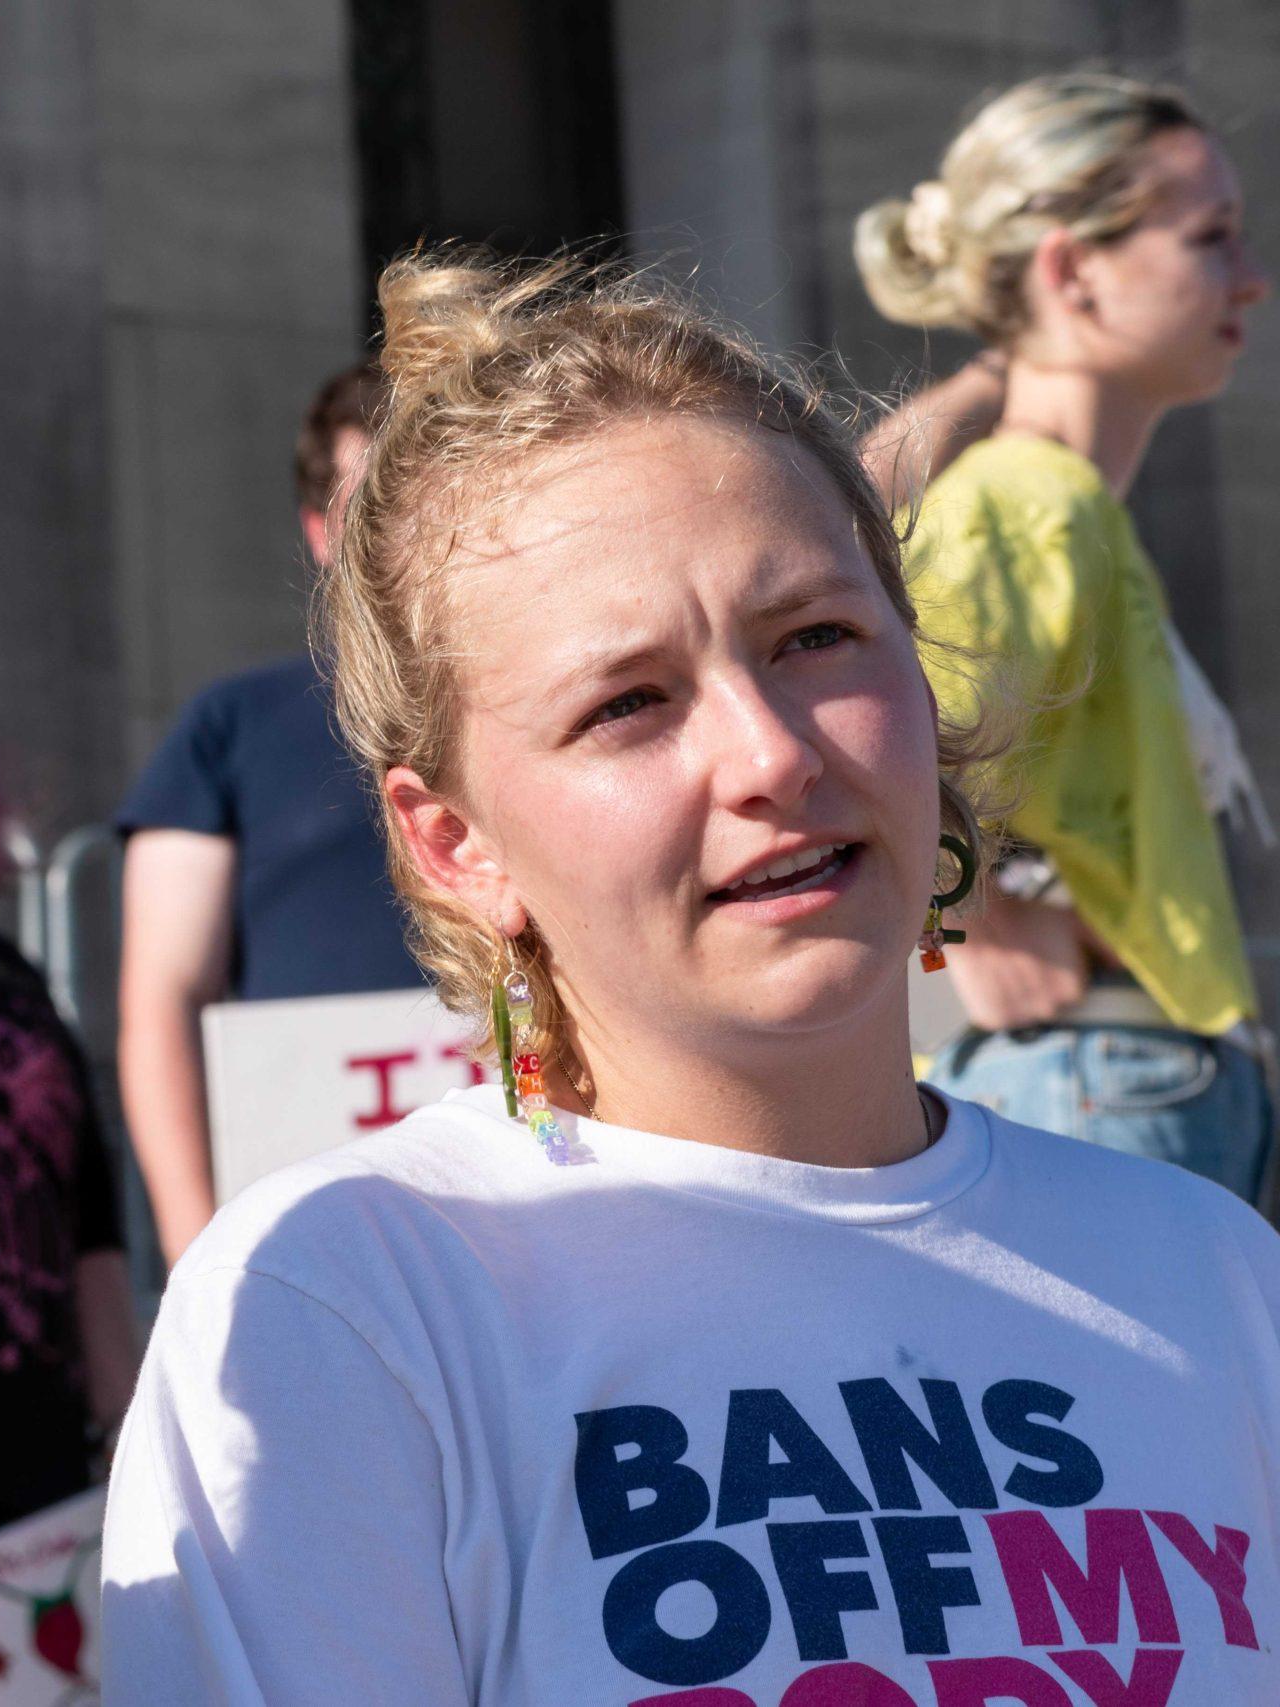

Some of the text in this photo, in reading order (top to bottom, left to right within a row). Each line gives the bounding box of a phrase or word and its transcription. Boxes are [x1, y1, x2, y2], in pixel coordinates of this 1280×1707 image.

[574, 1377, 1105, 1561] BANS
[602, 1508, 1260, 1687] OFF MY
